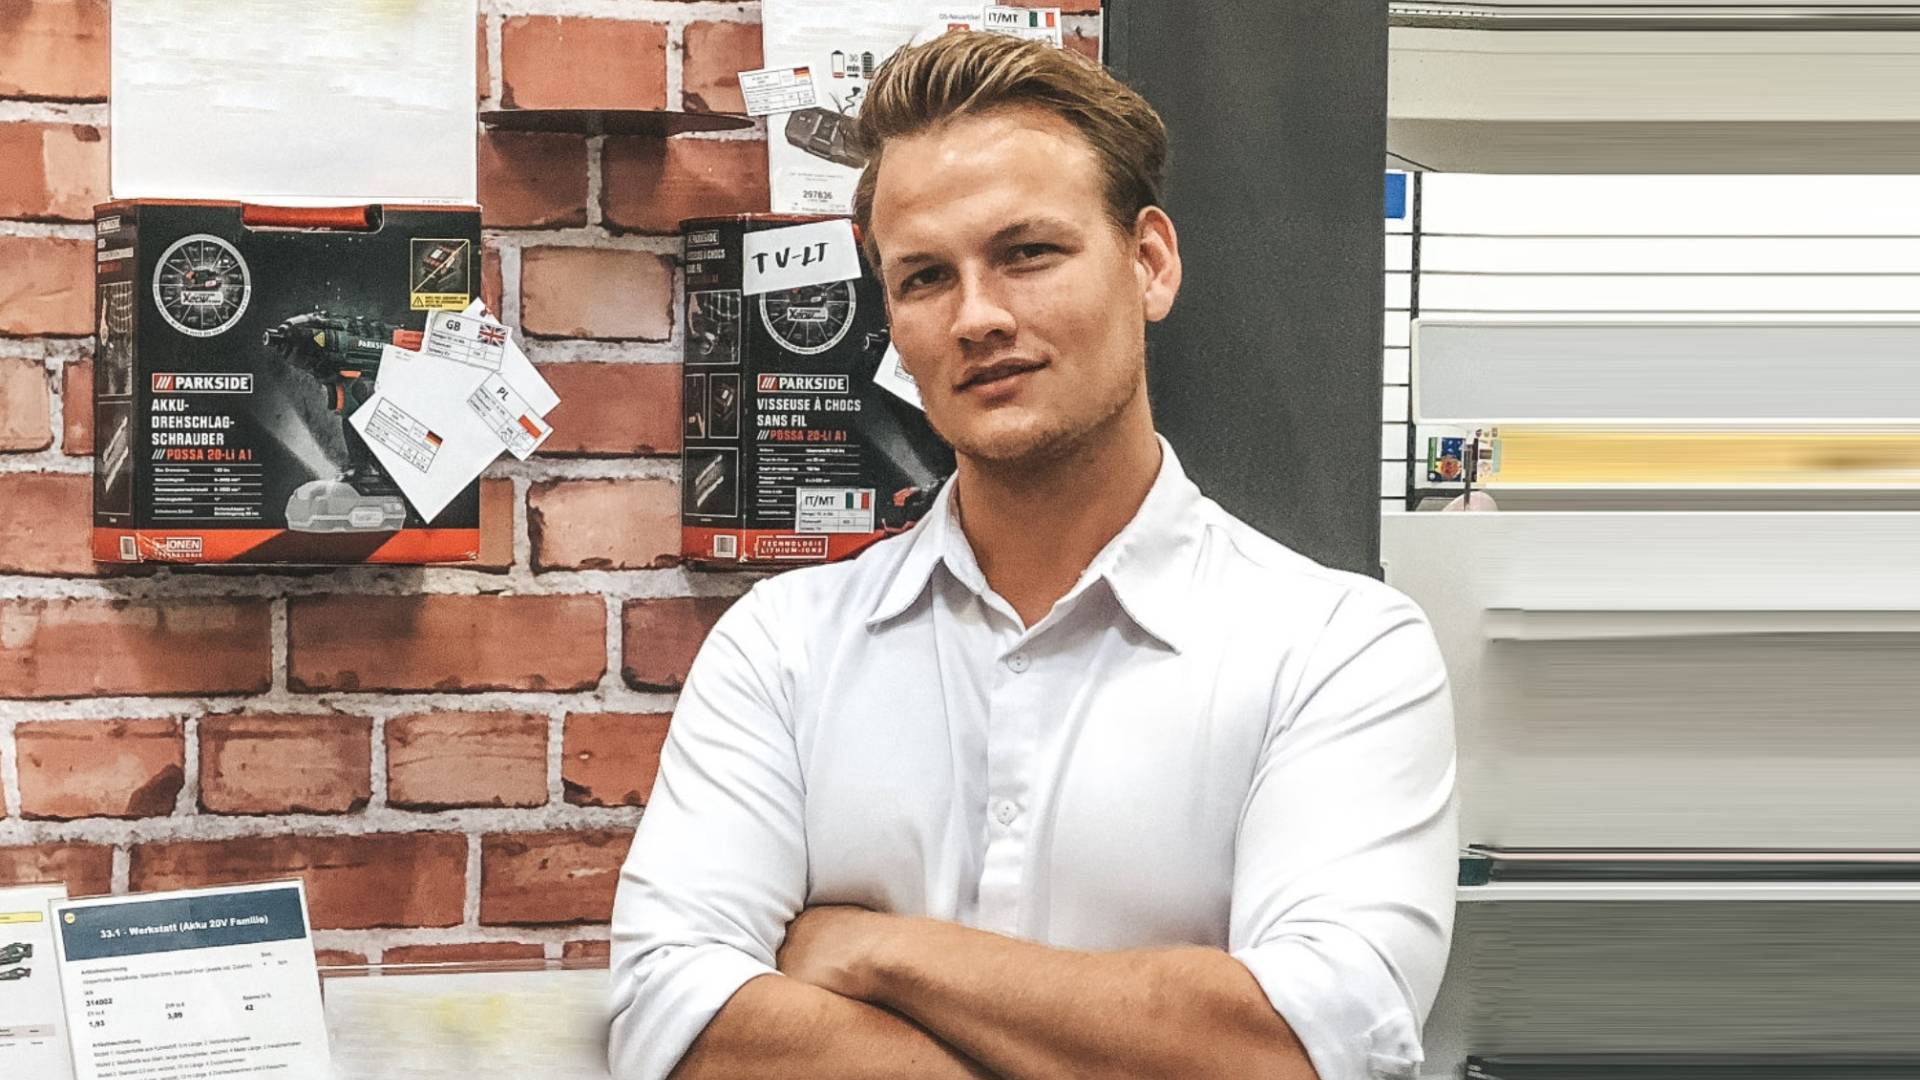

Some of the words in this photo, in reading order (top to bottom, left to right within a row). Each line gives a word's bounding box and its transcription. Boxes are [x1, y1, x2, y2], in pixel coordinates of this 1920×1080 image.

[988, 12, 1018, 24] IT/MT
[445, 319, 461, 332] GB
[175, 376, 249, 390] PARKSIDE
[779, 377, 845, 390] PARKSIDE
[496, 386, 509, 402] PL
[151, 399, 189, 412] AKKU-
[757, 398, 810, 411] VISSEUSE
[825, 399, 861, 412] CHOCS
[151, 415, 235, 429] DREHSCHLAG-
[757, 414, 788, 427] SANS
[791, 415, 807, 427] FIL
[151, 432, 225, 446] SCHRAUBER
[805, 495, 835, 507] IT/MT
[100, 929, 120, 939] 33.1
[129, 923, 178, 936] Werkstatt
[179, 918, 207, 933] (Akku
[209, 918, 228, 929] 20V
[230, 914, 269, 926] Familie)
